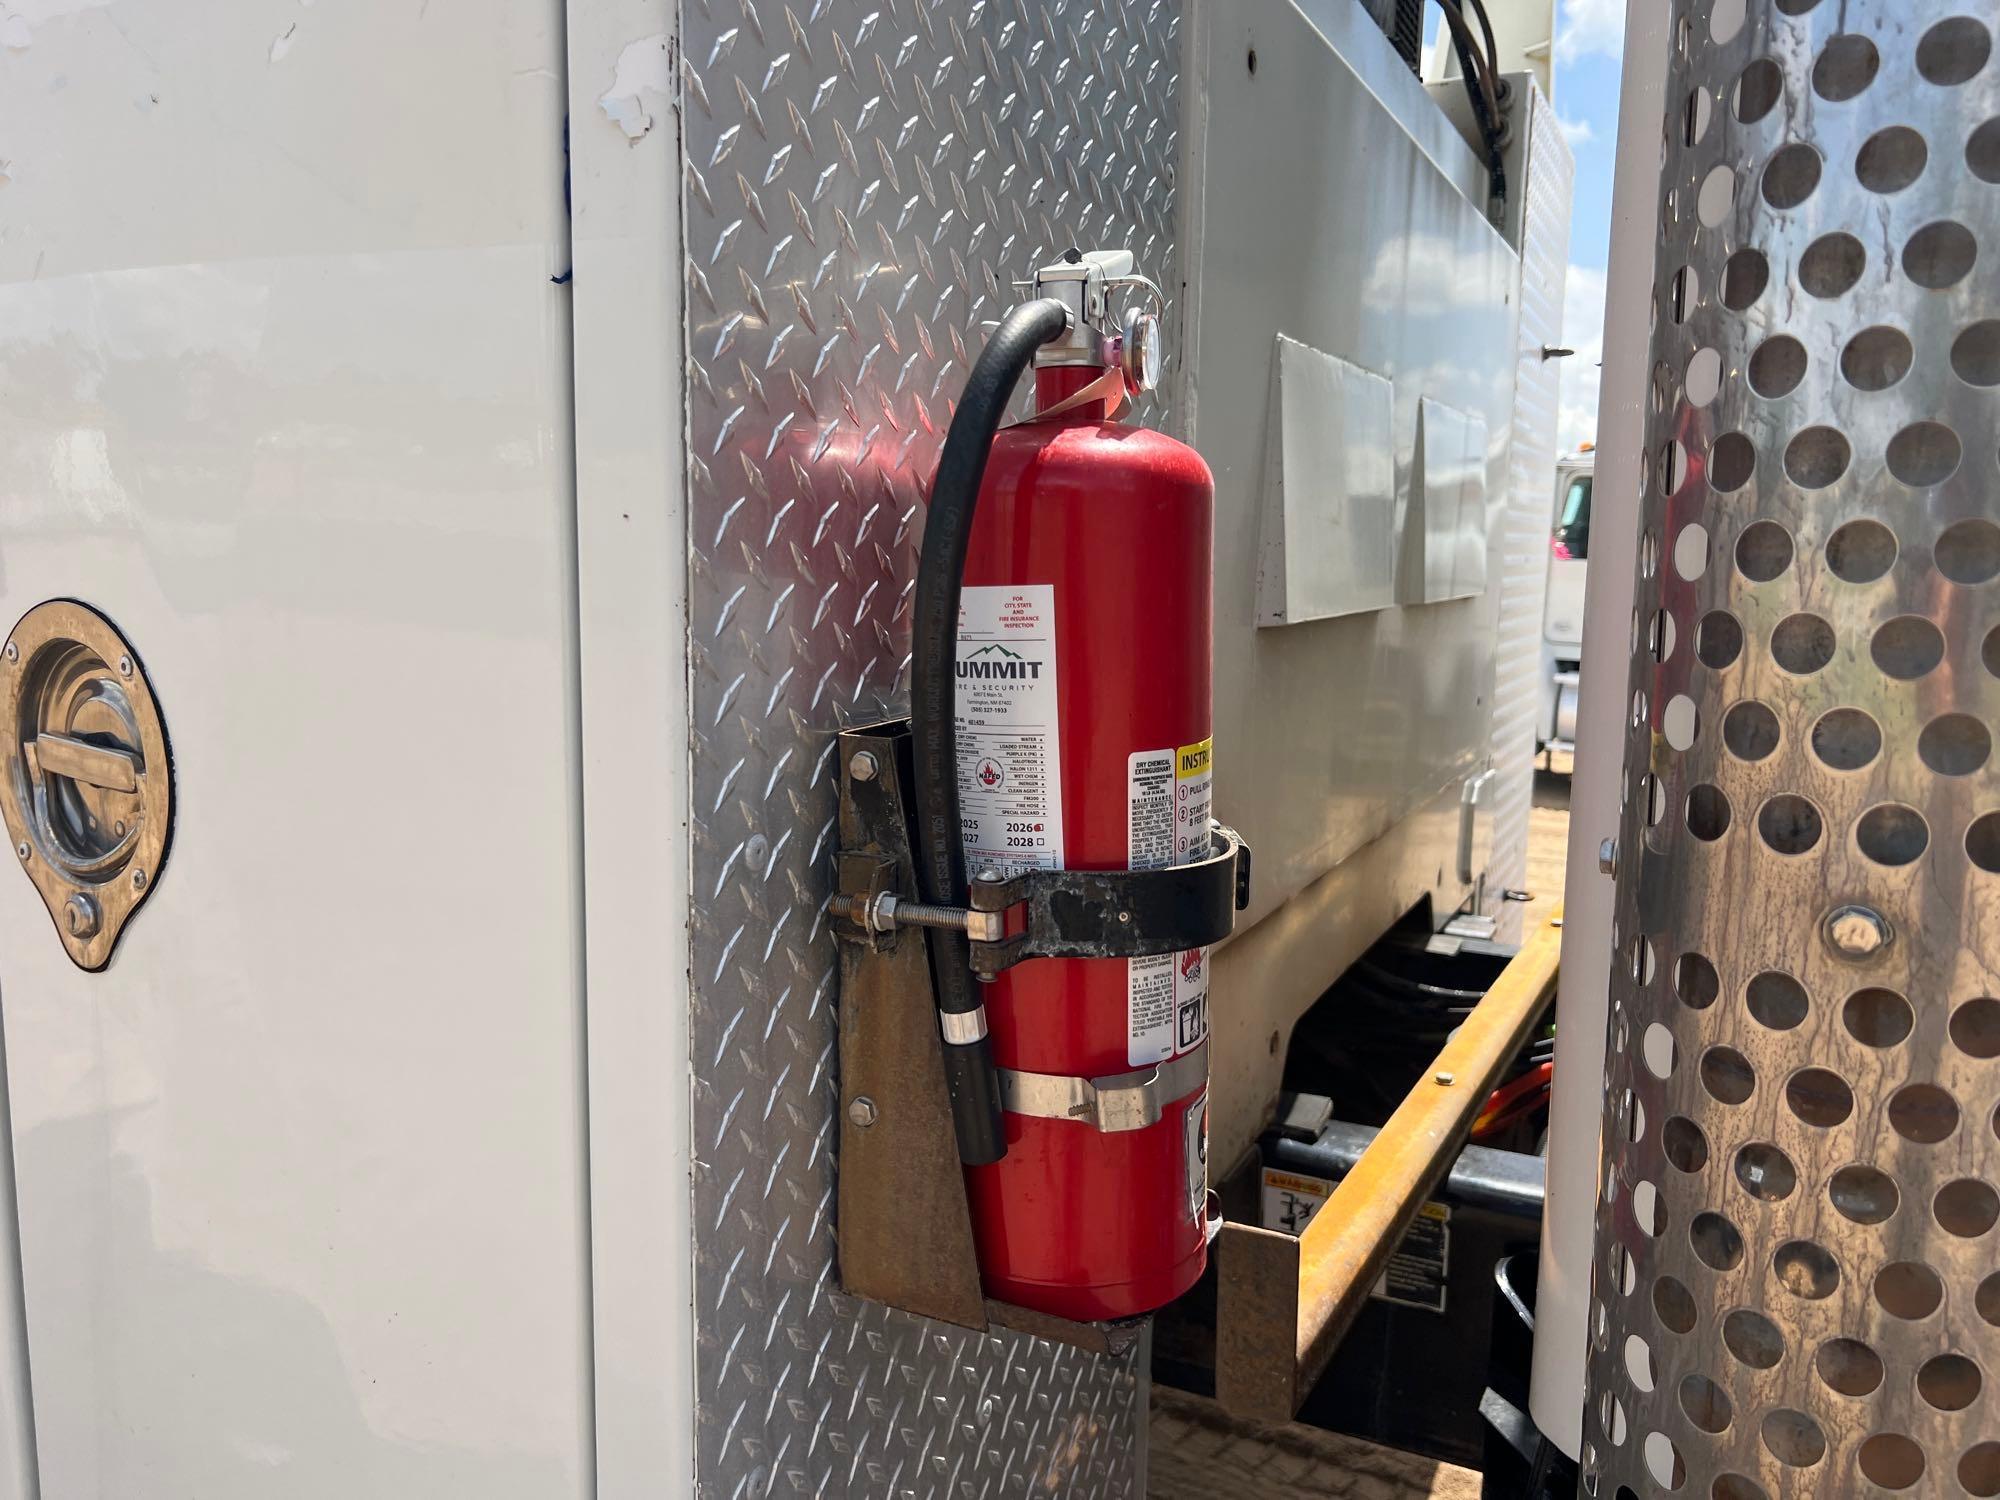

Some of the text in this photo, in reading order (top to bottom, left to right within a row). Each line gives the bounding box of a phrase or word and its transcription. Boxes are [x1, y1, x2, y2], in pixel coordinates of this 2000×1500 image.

[955, 661, 1042, 679] UMMIT
[1147, 759, 1170, 767] CHEMICAL
[1182, 749, 1209, 771] INSTR
[960, 818, 1033, 833] 2025 2026
[963, 833, 1034, 847] 027 2028
